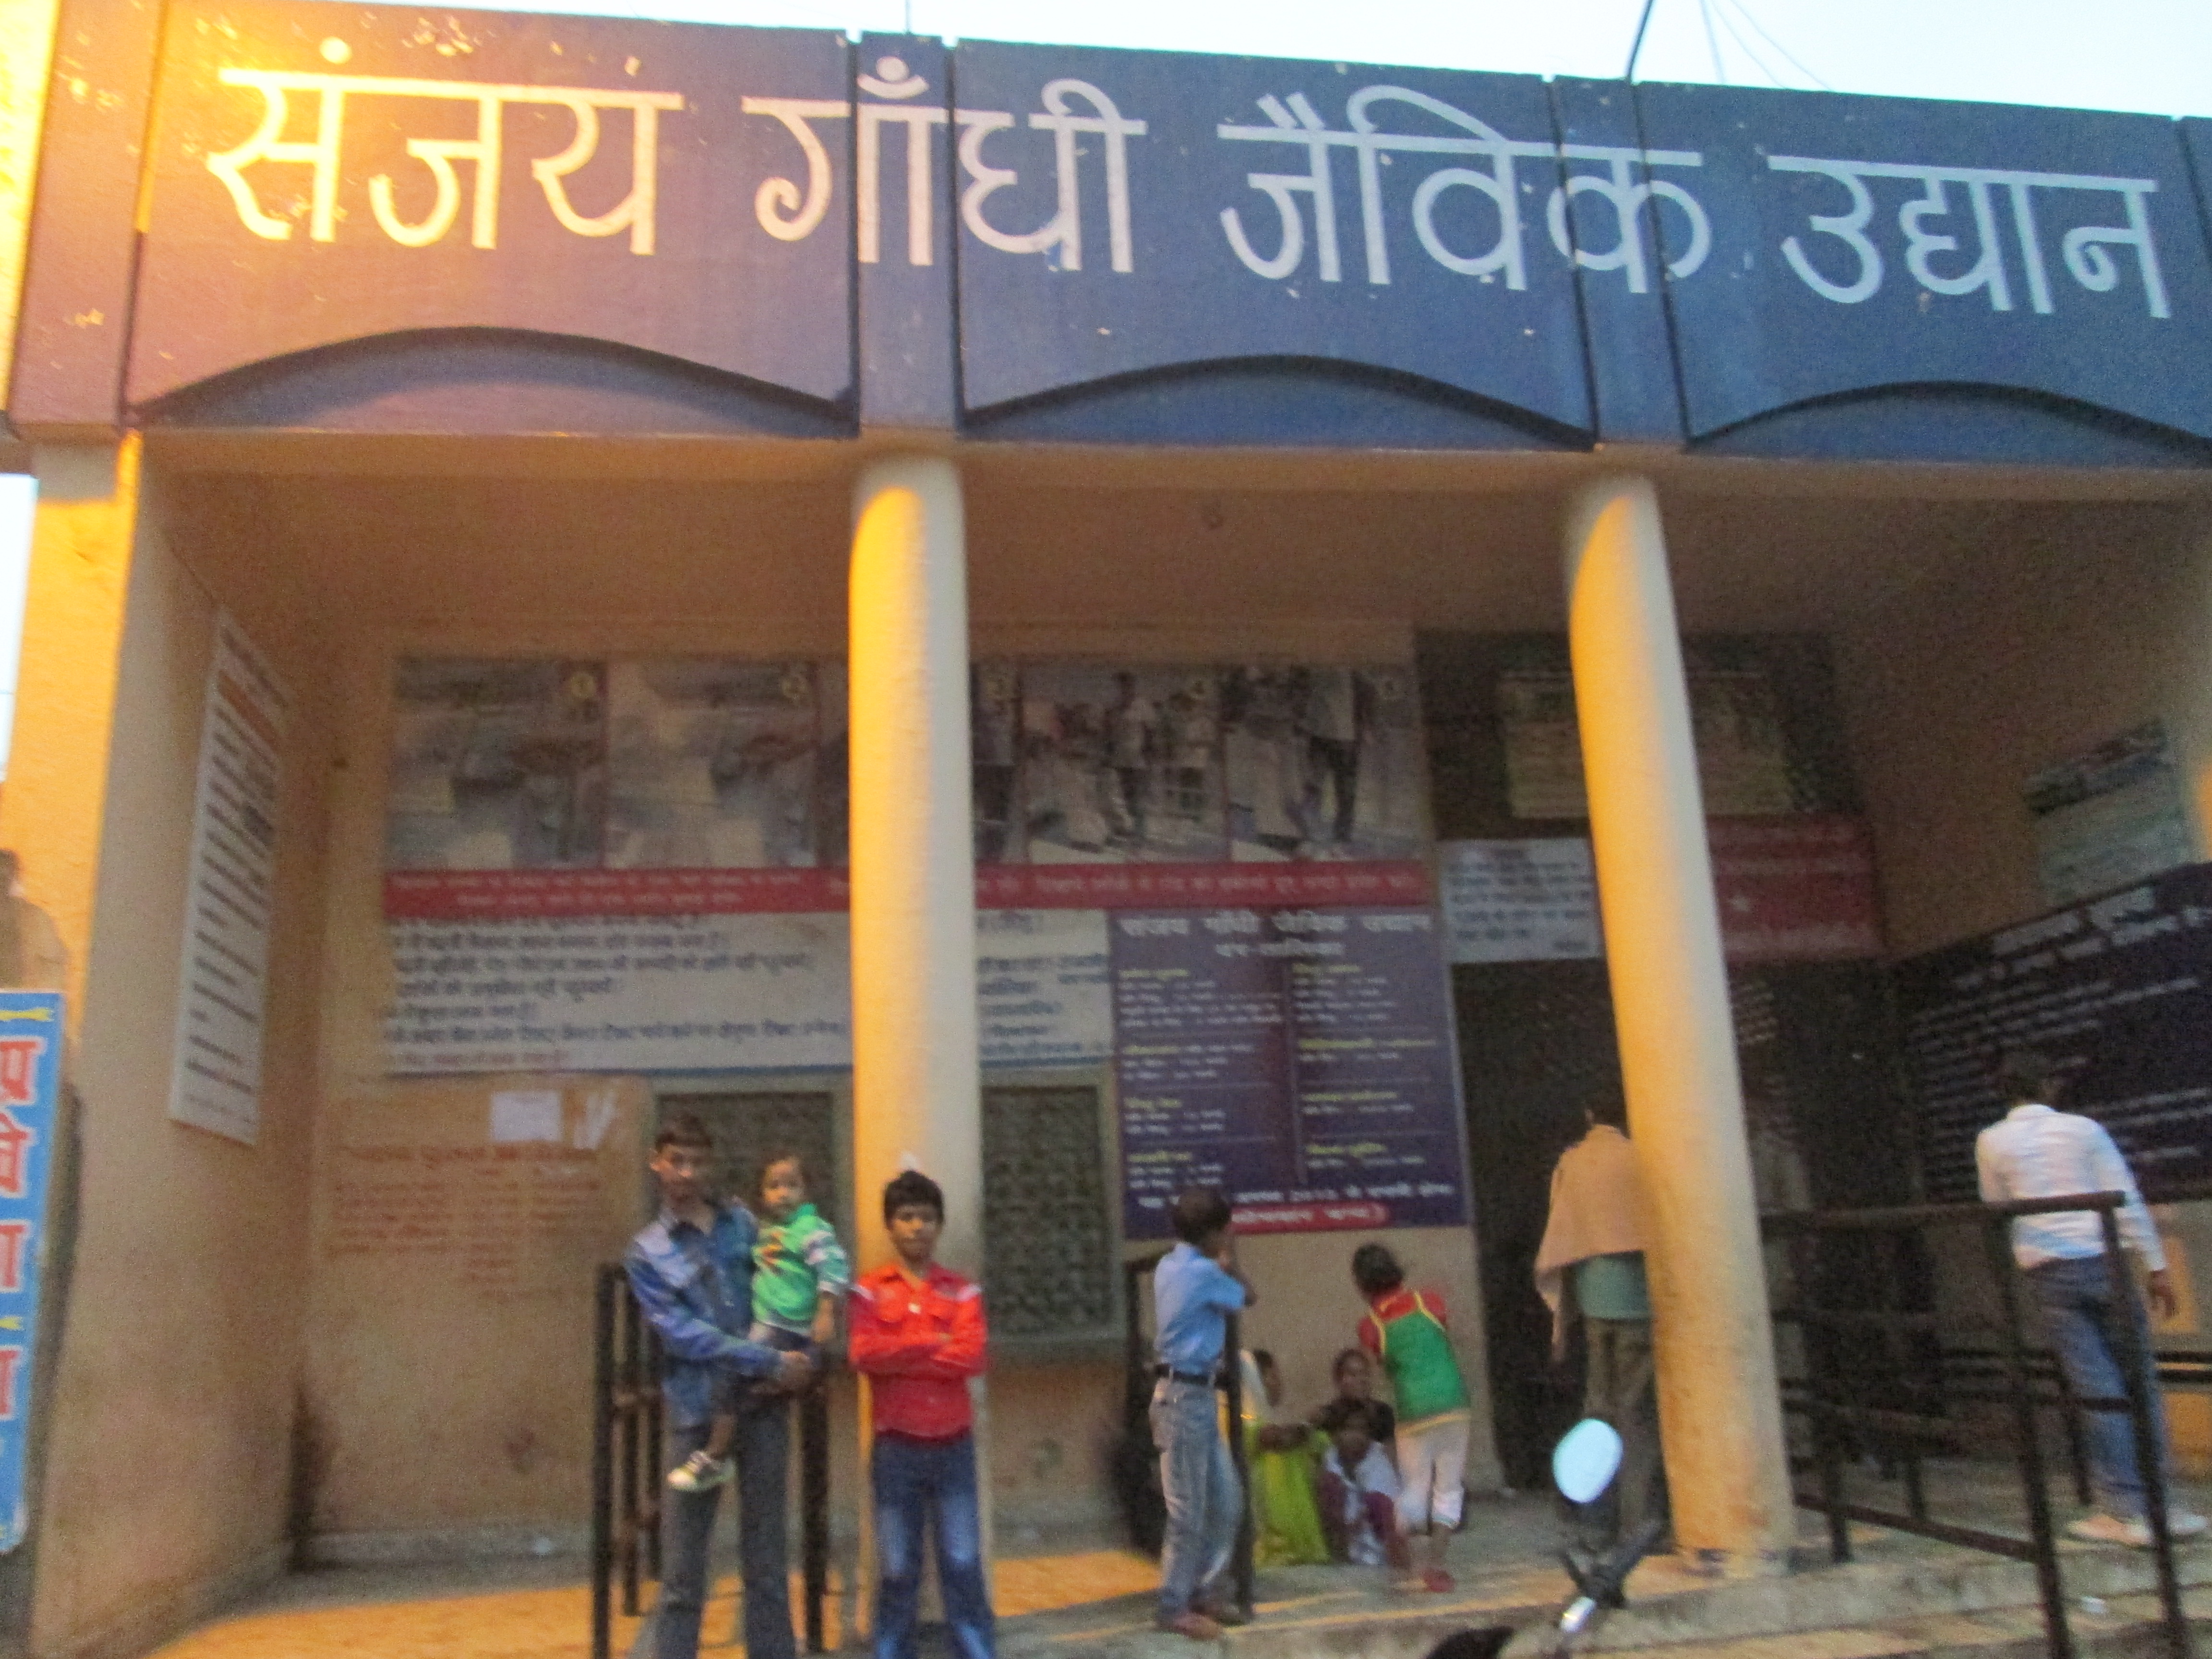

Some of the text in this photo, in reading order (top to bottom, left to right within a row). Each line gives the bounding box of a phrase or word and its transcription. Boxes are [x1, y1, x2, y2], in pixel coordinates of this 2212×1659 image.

[206, 37, 685, 256] संजय
[1216, 84, 1710, 293] जैविक
[1767, 155, 2171, 318] उद्यान
